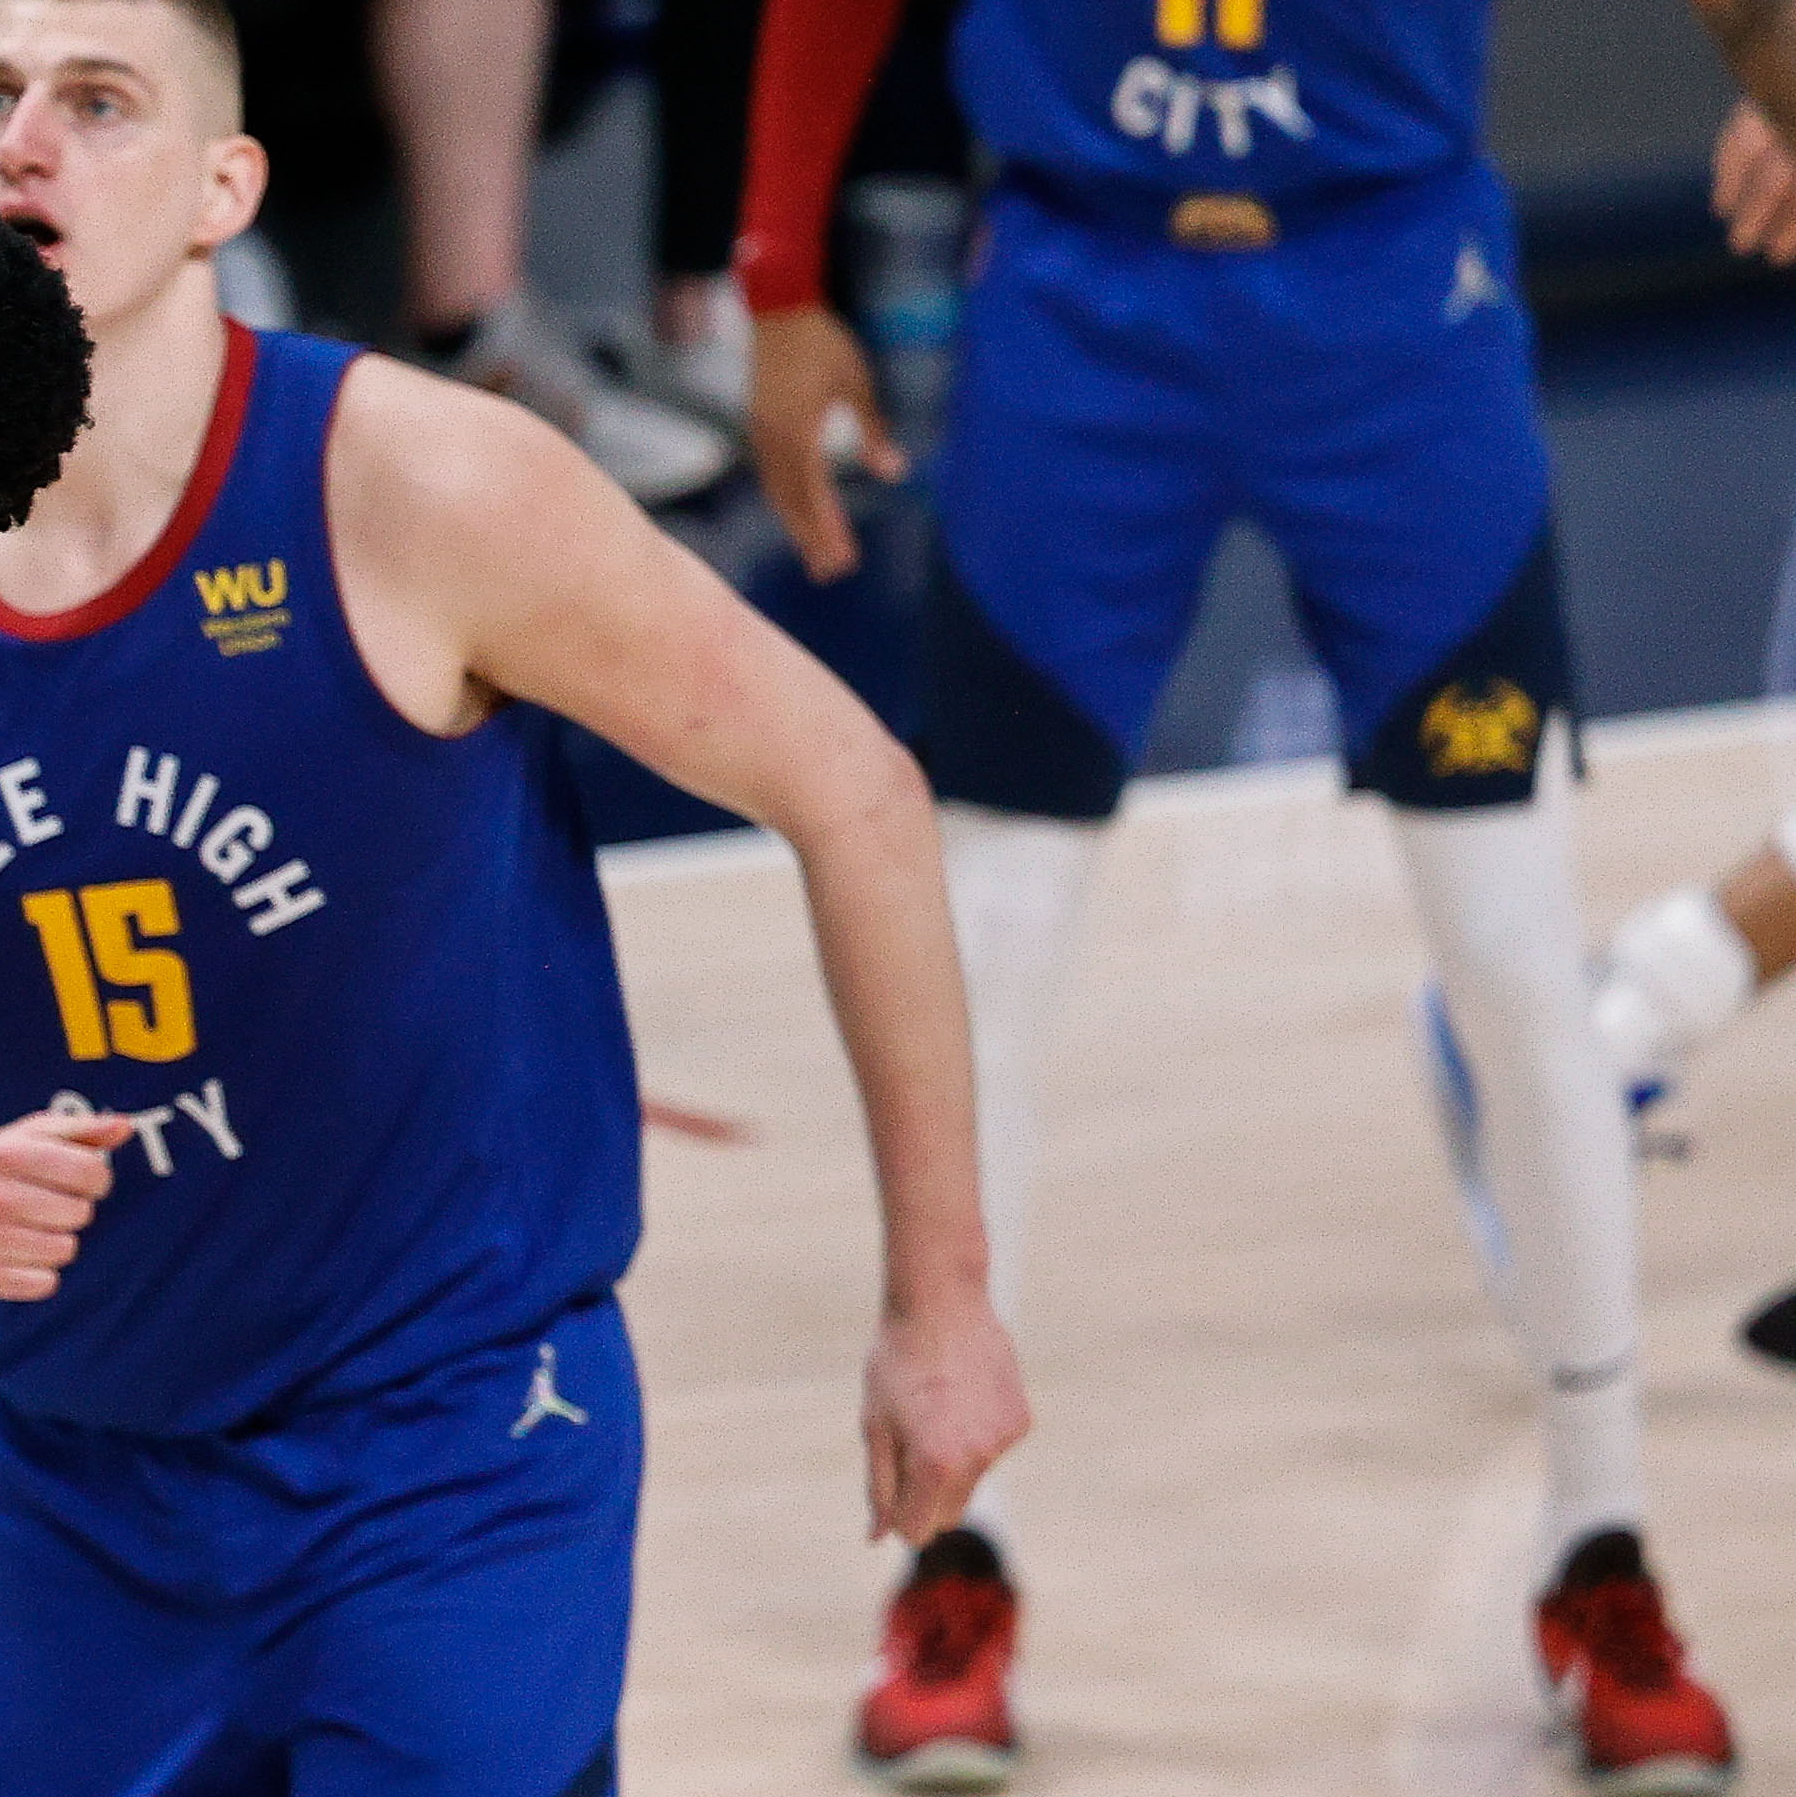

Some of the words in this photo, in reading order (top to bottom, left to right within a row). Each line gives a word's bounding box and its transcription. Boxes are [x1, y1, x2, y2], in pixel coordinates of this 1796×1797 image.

[1109, 54, 1317, 158] CITY
[193, 557, 288, 616] WU
[116, 745, 327, 937] HIGH
[21, 877, 197, 1063] 15
